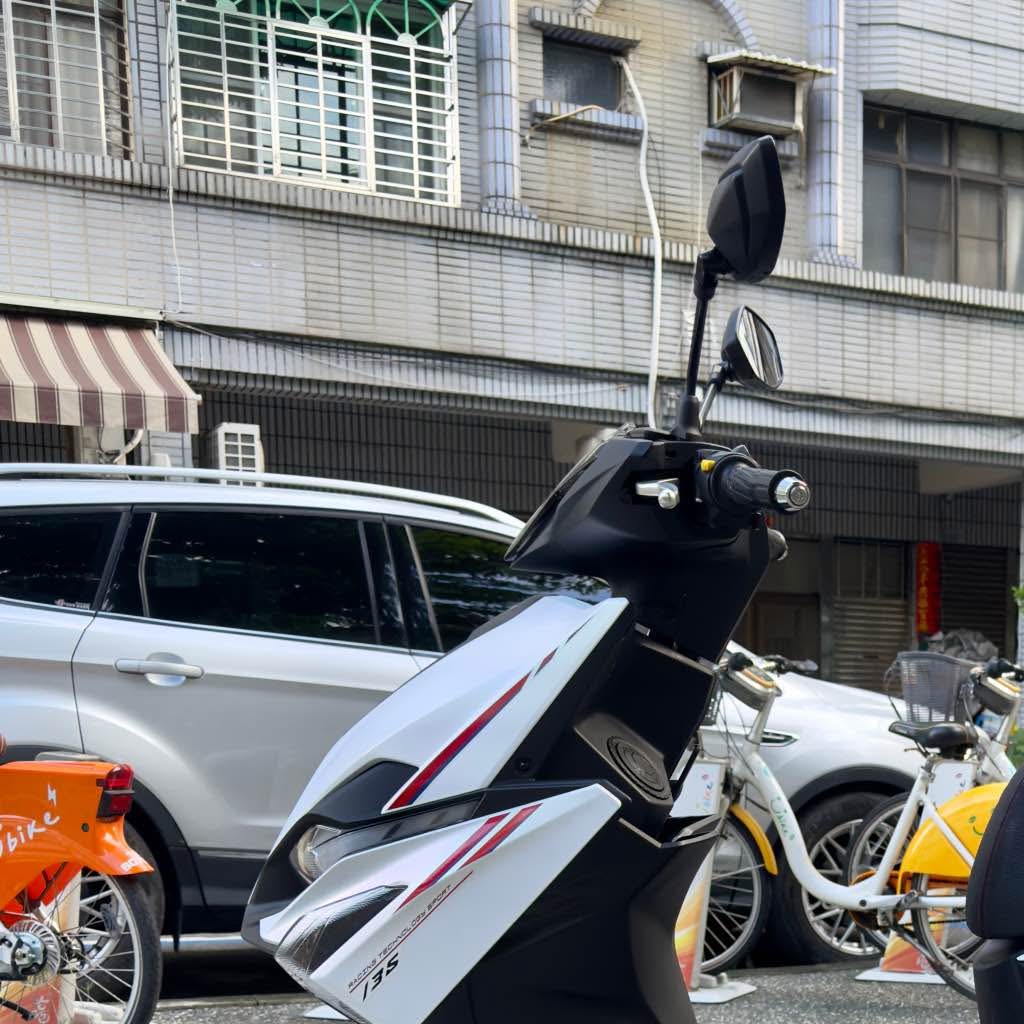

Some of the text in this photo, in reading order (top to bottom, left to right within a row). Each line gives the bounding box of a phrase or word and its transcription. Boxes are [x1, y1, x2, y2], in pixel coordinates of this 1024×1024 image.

[0, 812, 60, 857] bike
[348, 884, 452, 989] RACING TECHNOLOGY SPORT
